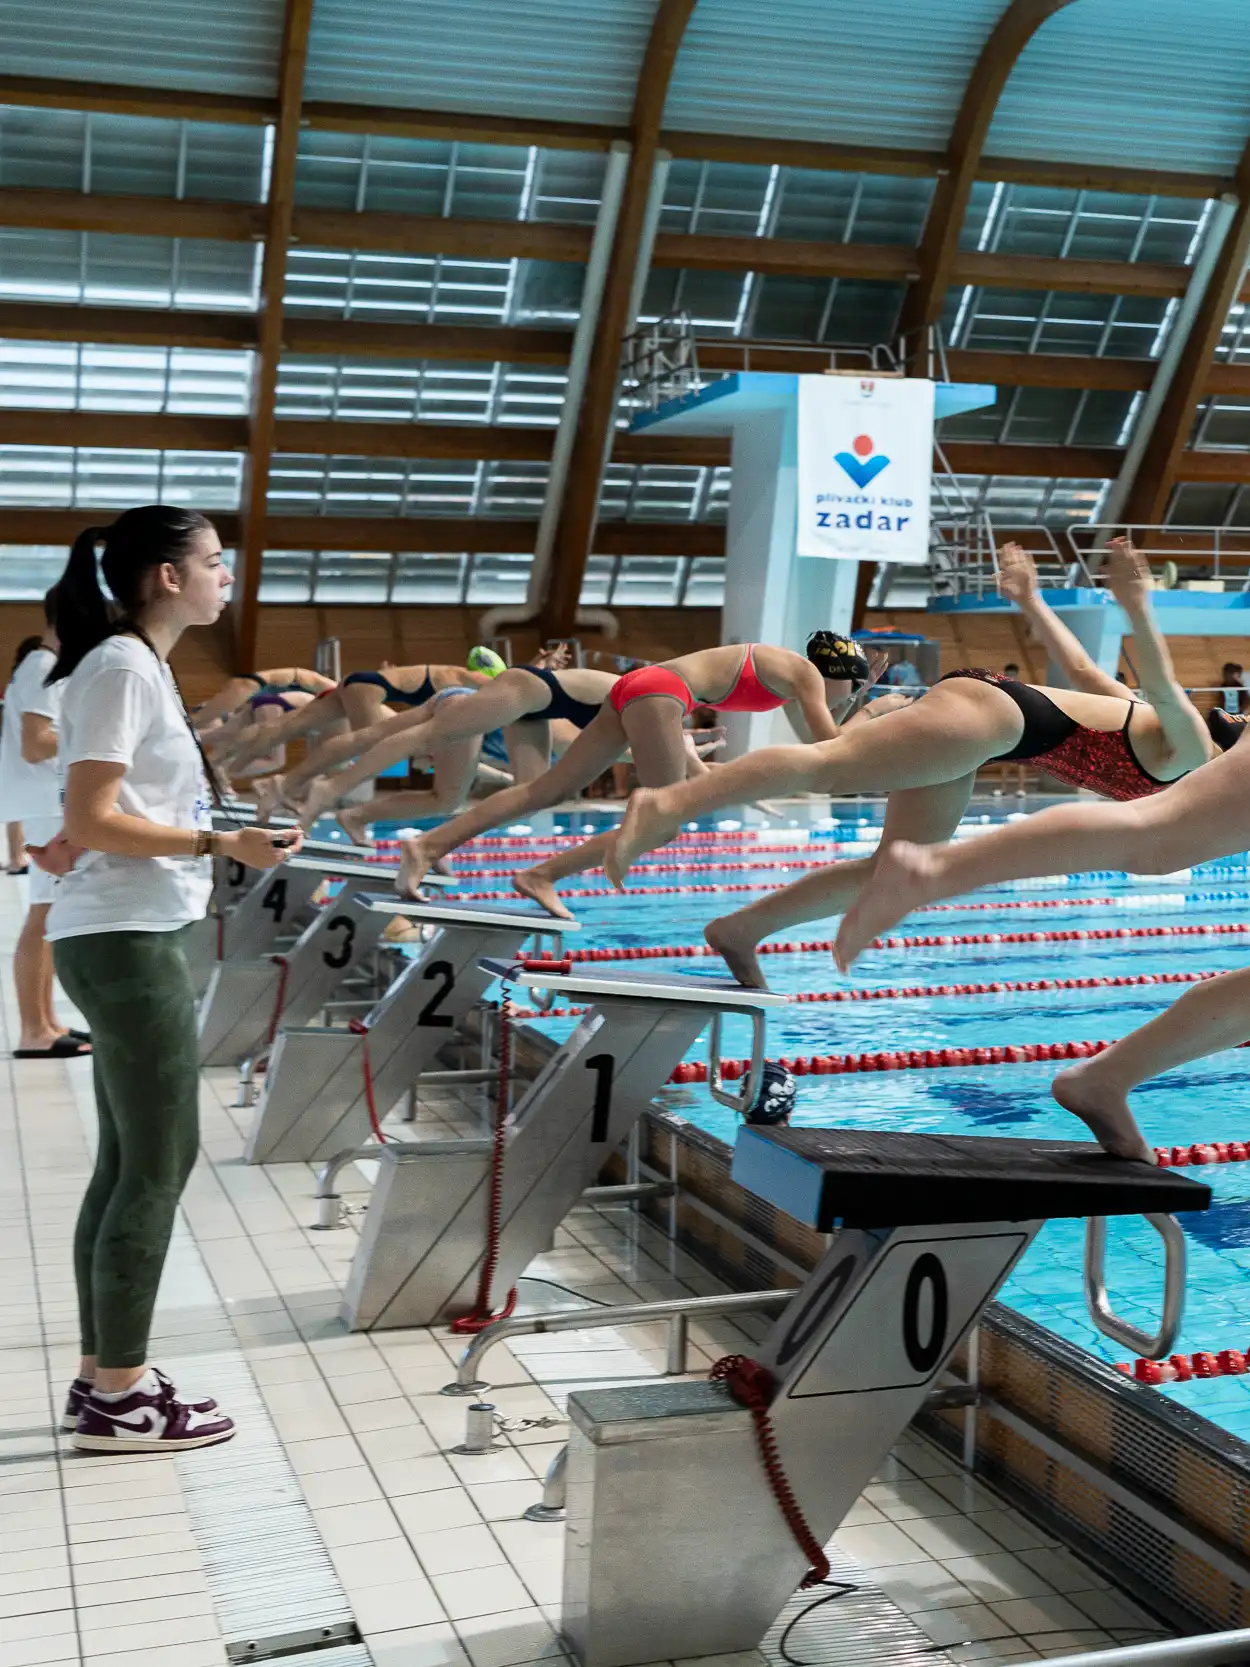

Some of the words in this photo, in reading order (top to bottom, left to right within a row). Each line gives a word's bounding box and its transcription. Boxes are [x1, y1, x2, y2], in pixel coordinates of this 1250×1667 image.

[816, 510, 910, 531] zadar
[881, 497, 913, 507] klub
[262, 879, 287, 923] 4
[323, 915, 356, 969] 3
[417, 960, 455, 1028] 2
[585, 1053, 615, 1143] 1
[776, 1254, 857, 1366] 0
[903, 1252, 948, 1373] 0
